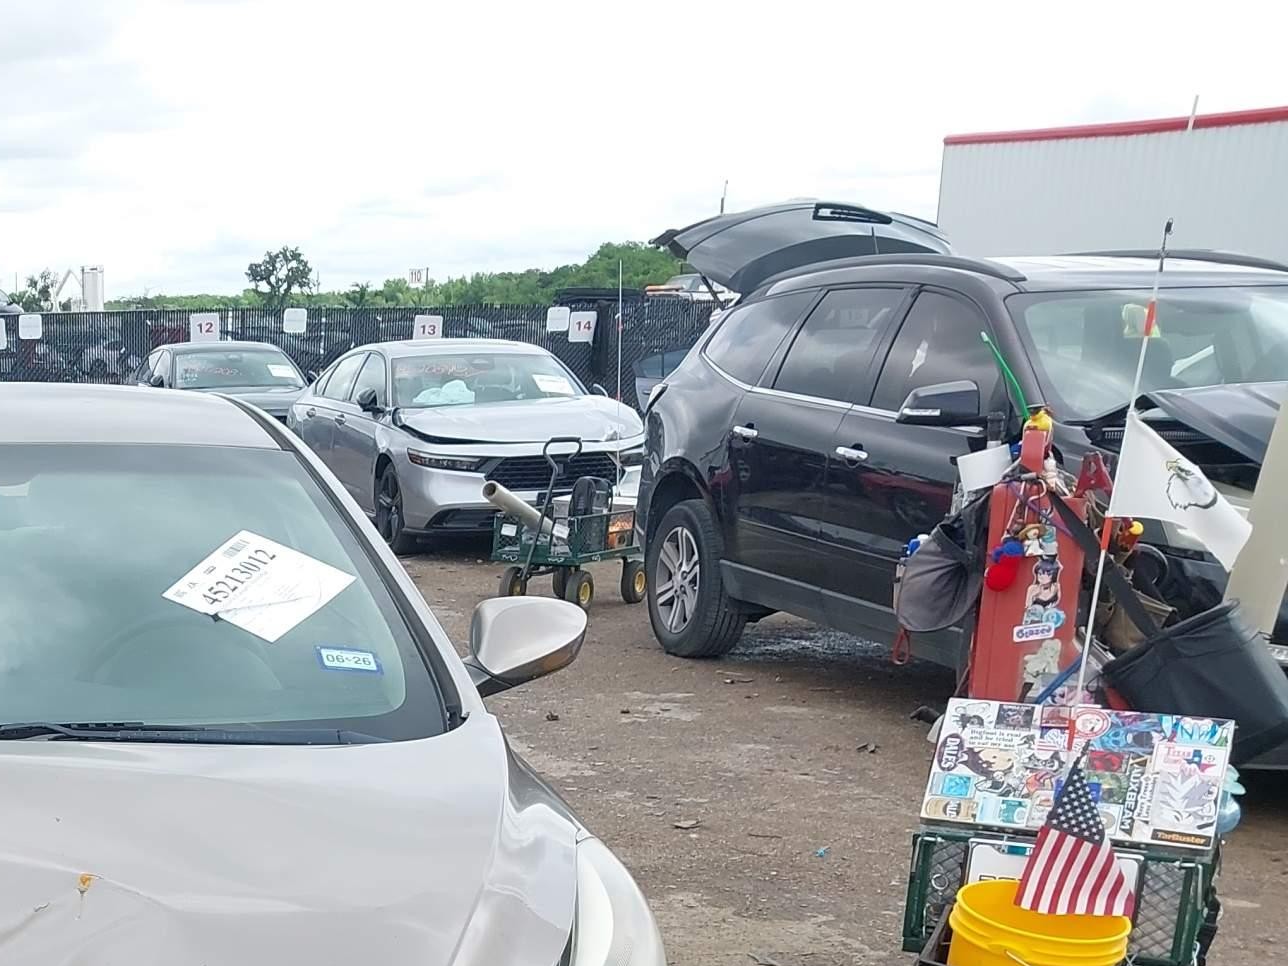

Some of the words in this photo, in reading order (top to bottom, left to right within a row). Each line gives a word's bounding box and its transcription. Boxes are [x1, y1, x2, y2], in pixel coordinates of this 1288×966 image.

[197, 322, 214, 334] 12
[420, 324, 437, 336] 13
[575, 320, 592, 331] 14
[202, 549, 277, 605] 45213012
[1120, 765, 1142, 830] AUXBEAM
